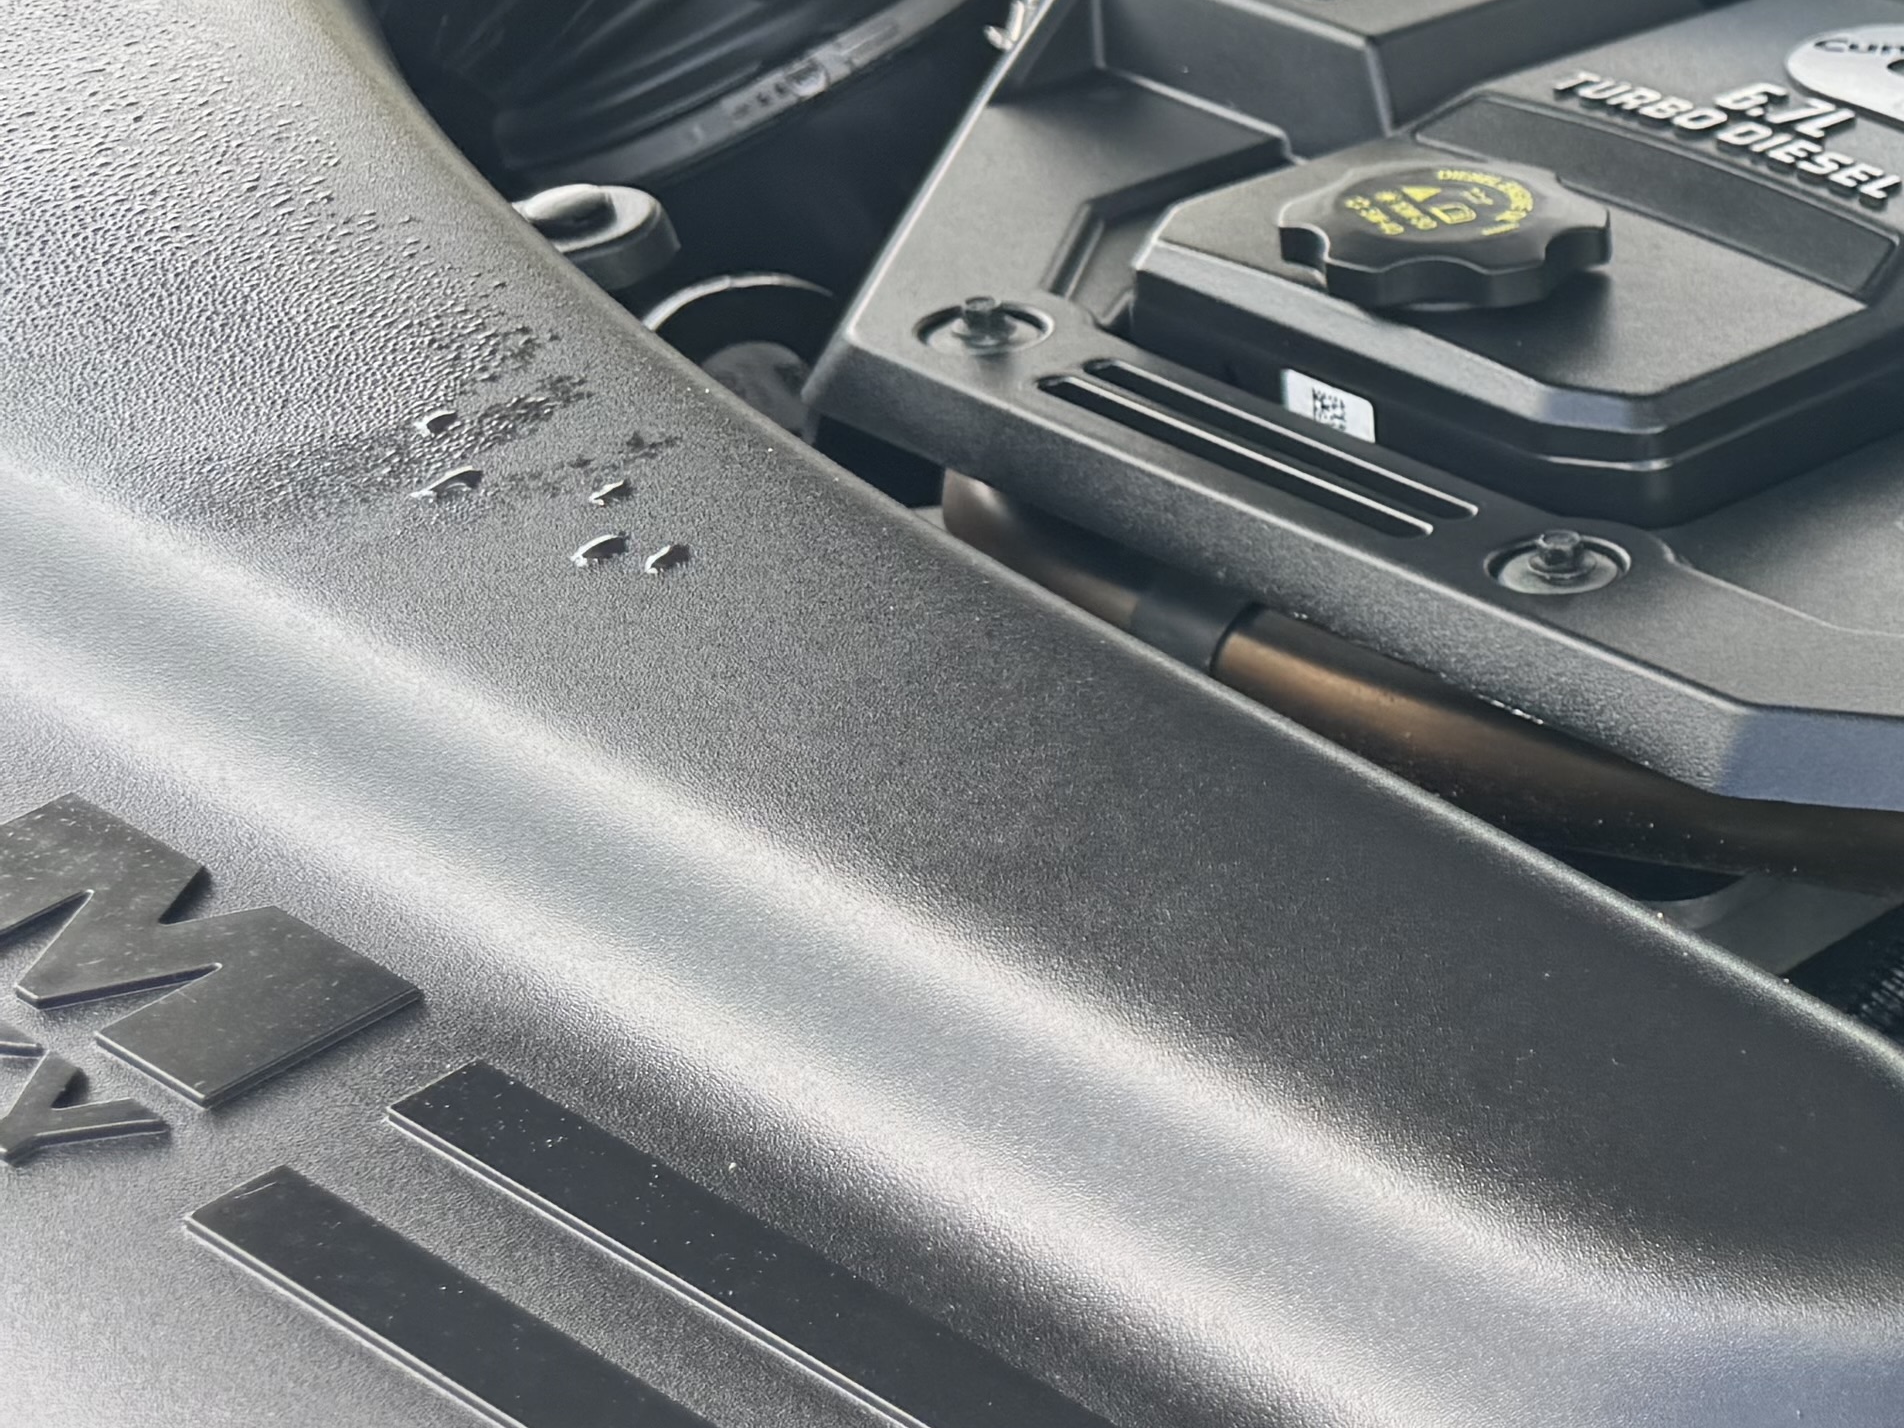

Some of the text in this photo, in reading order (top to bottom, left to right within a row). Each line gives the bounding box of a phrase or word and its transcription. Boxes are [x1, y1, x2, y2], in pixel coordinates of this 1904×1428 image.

[1552, 71, 1904, 202] TURBO DIESEL
[1713, 82, 1857, 140] 6.7L
